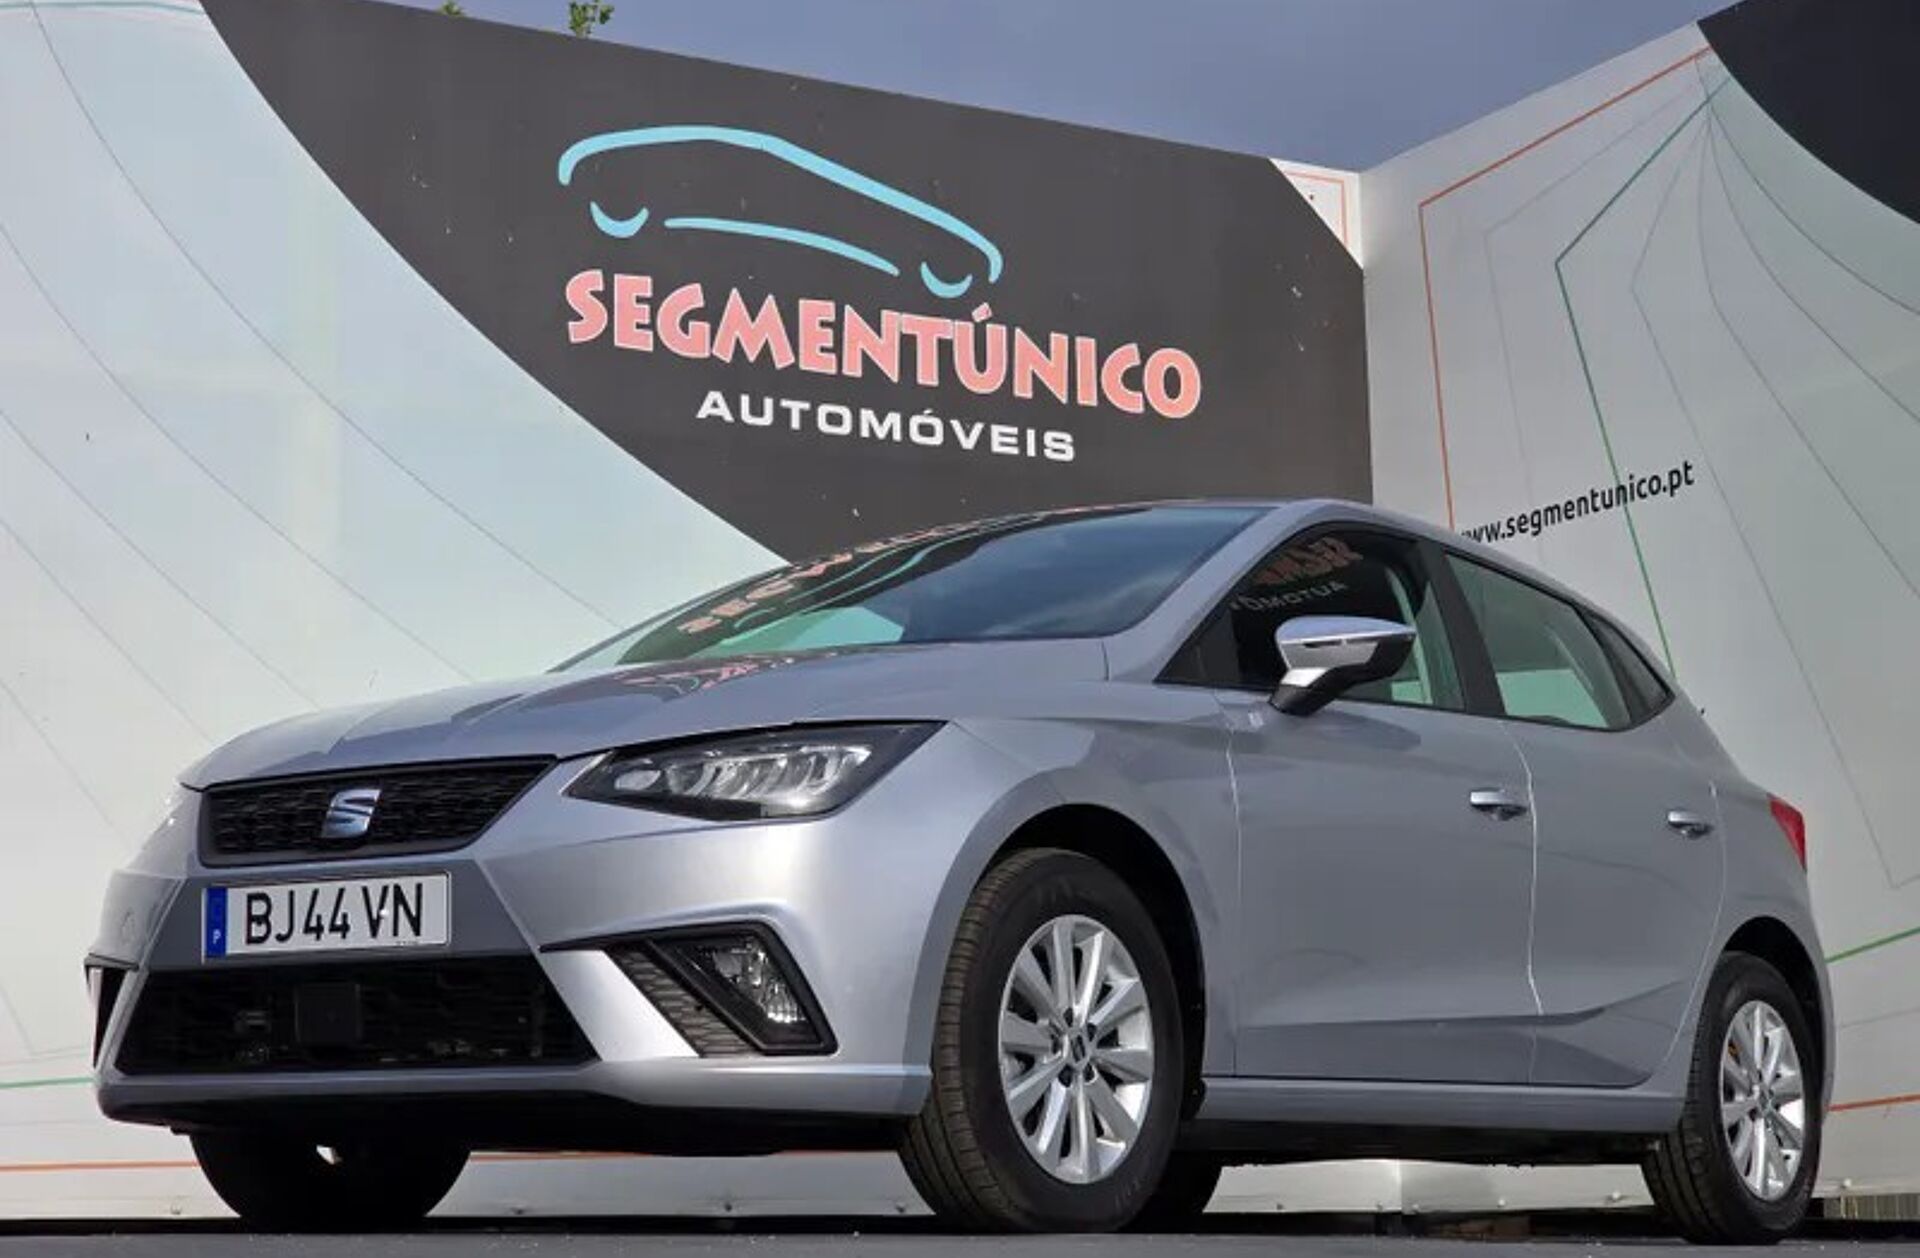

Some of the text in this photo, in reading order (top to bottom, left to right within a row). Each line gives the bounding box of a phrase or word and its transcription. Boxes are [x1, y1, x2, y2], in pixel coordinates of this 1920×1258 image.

[565, 269, 1201, 419] SEGMENTÚNICO
[697, 390, 1075, 461] AUTOMÓVEIS
[1461, 460, 1695, 543] ww.segmentunico.pt
